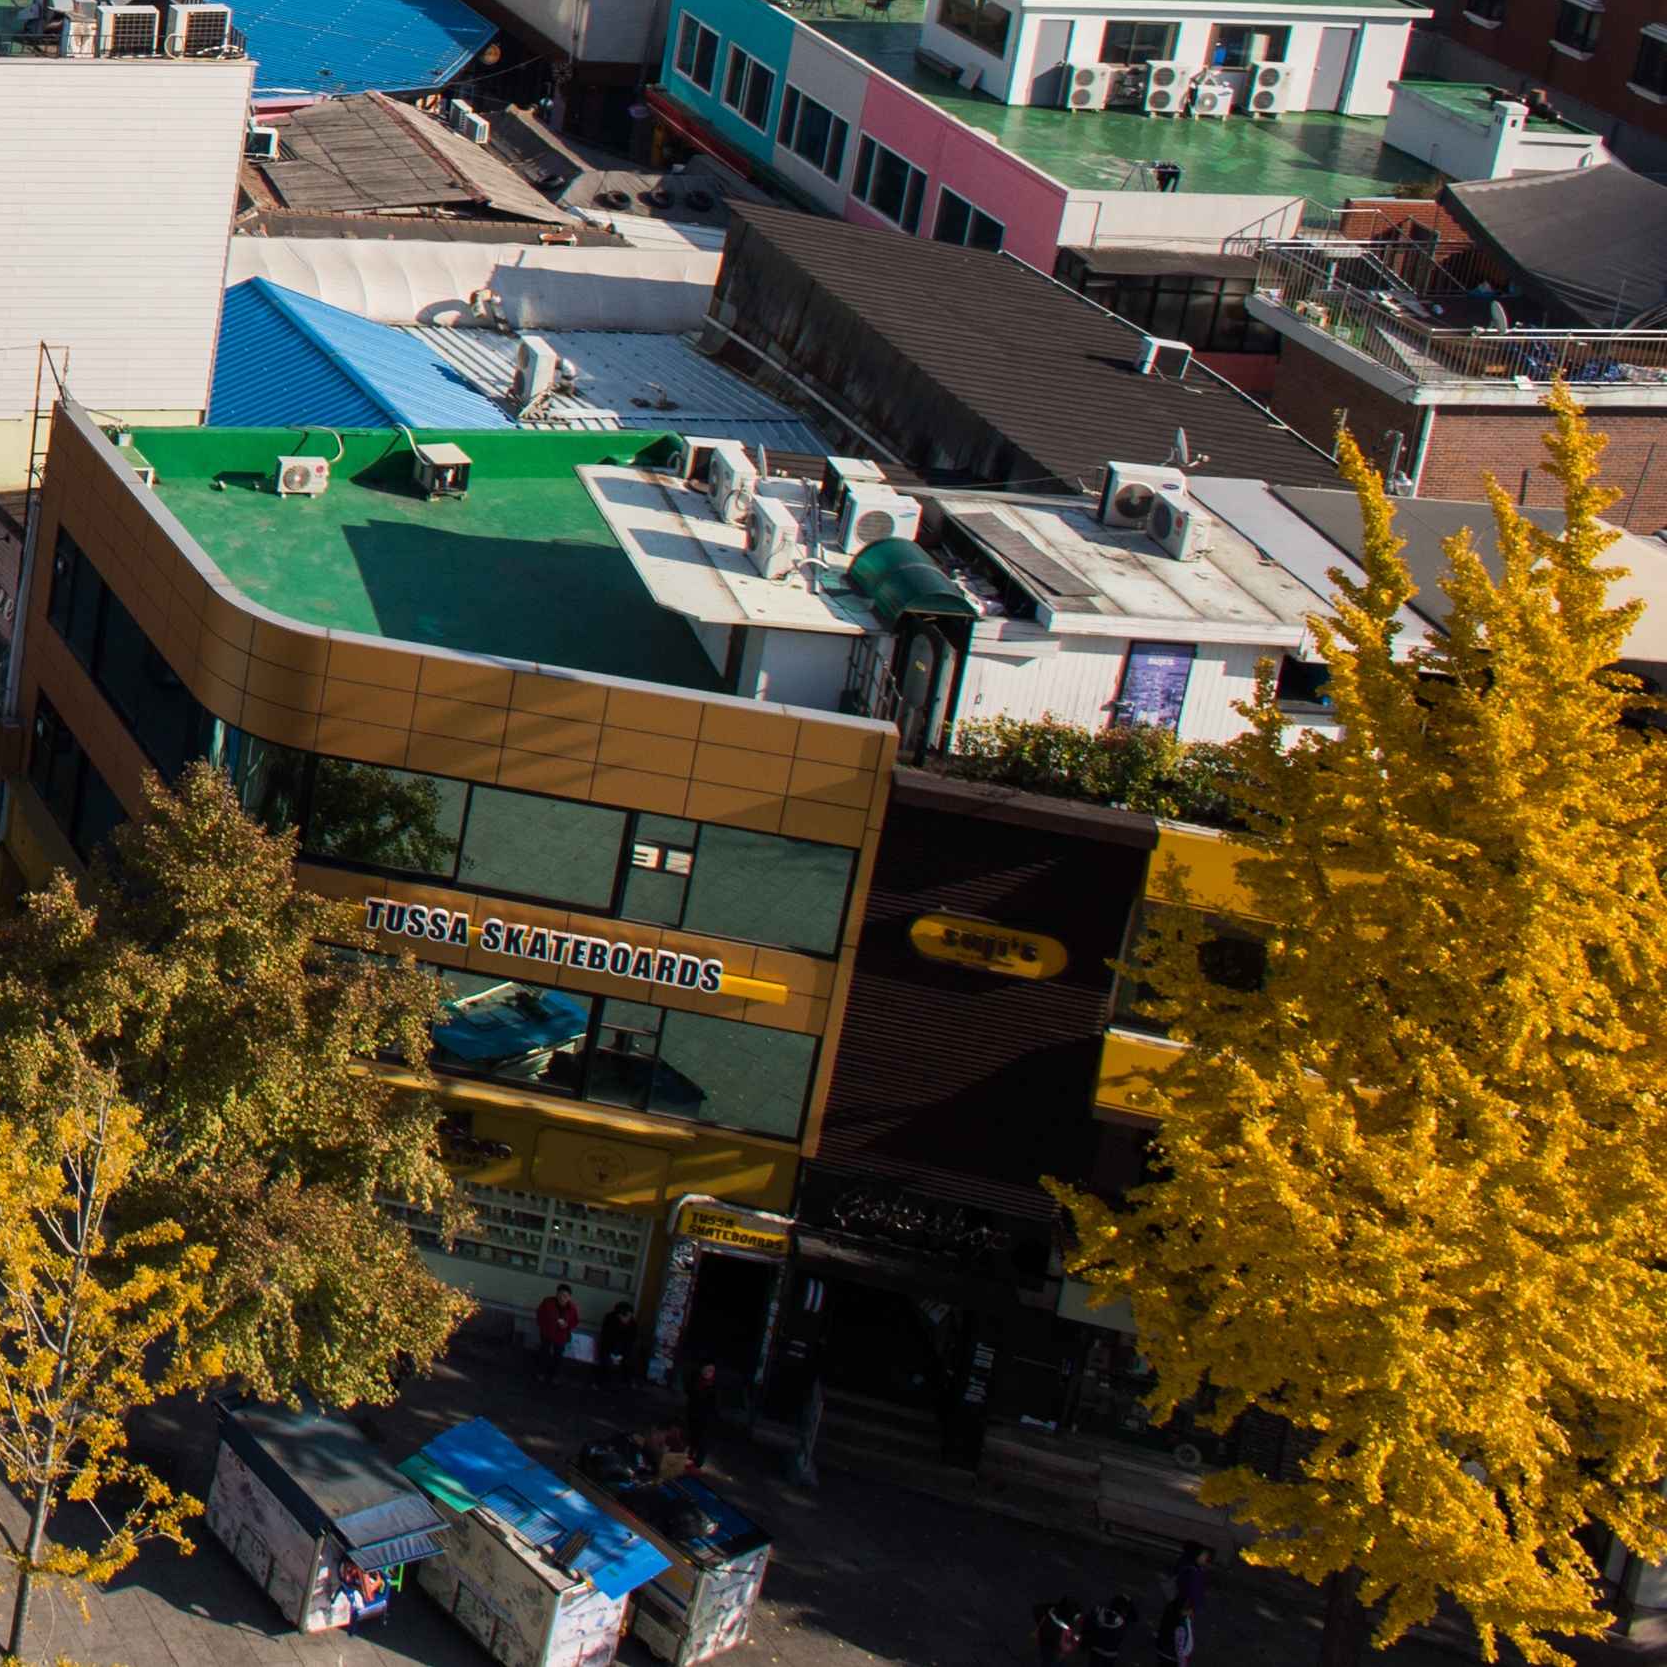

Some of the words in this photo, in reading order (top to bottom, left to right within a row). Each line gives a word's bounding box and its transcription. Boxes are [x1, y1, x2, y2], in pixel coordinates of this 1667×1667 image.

[365, 896, 470, 947] TUSSA
[479, 917, 724, 994] SKATEBOARDS
[691, 1212, 735, 1229] TUSSA
[687, 1223, 784, 1250] SKATEBOARDS
